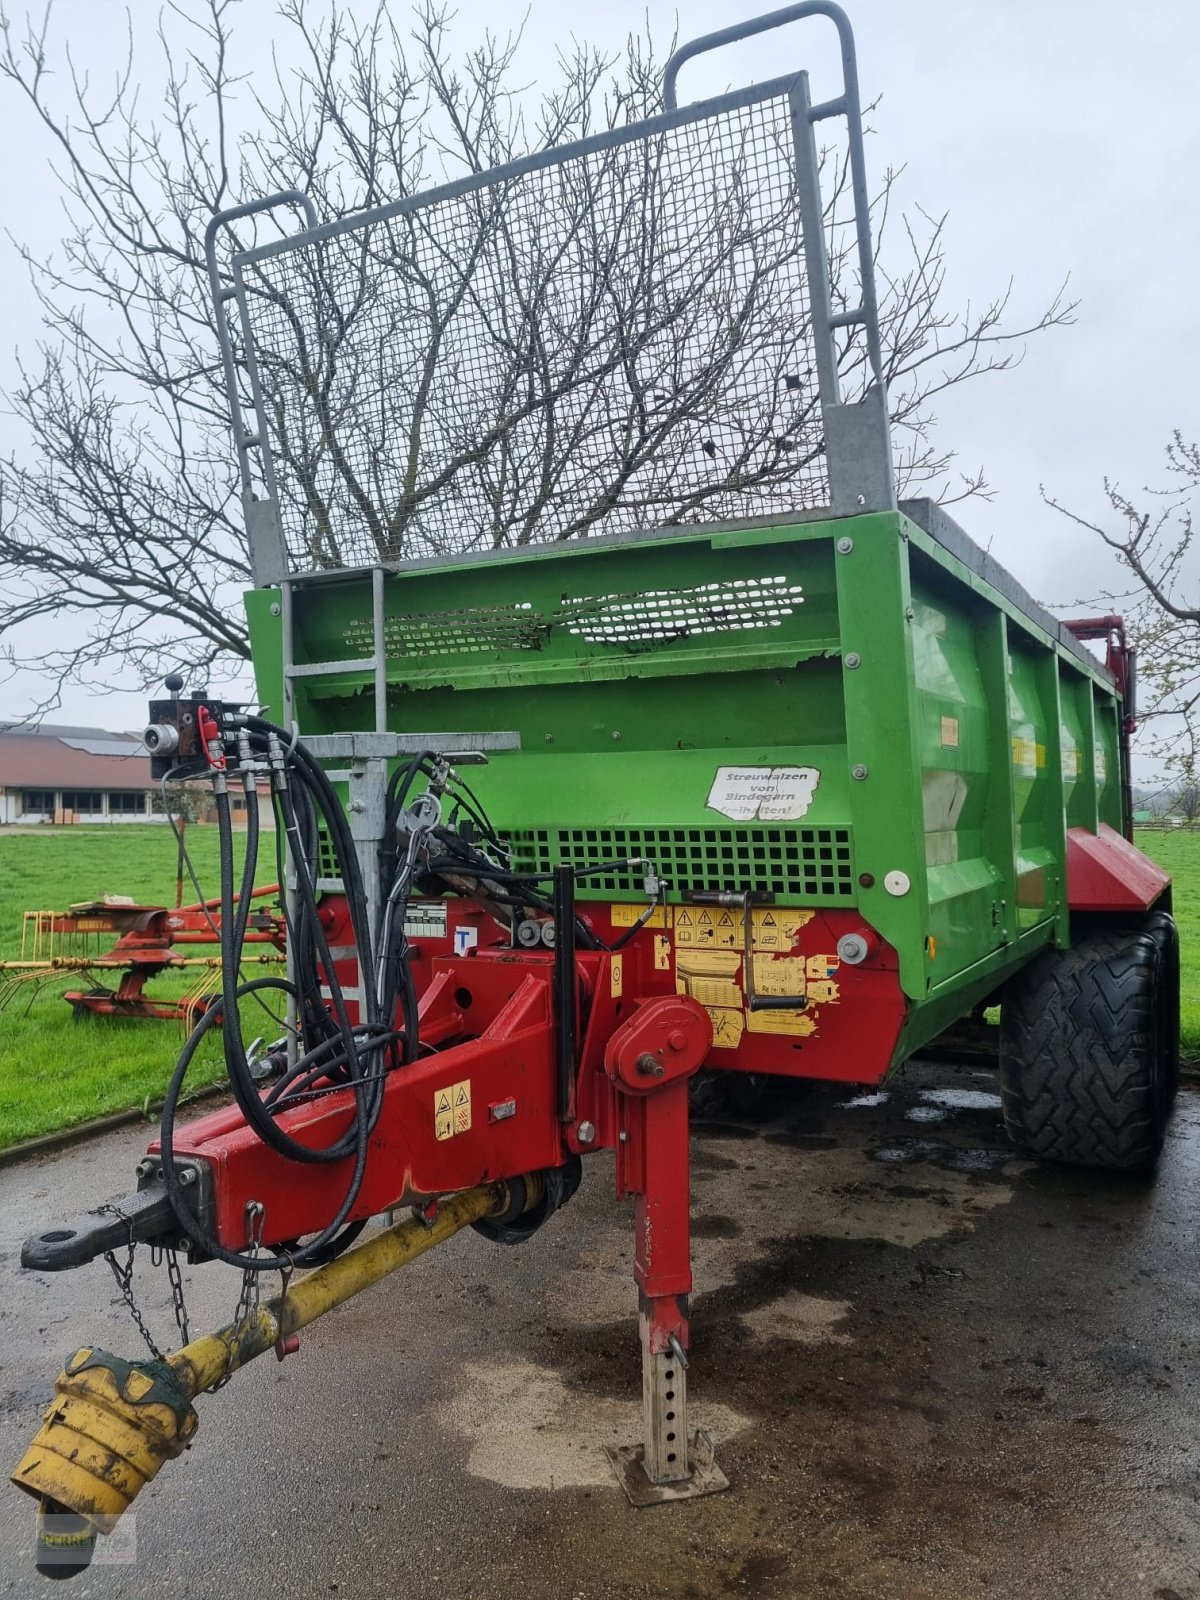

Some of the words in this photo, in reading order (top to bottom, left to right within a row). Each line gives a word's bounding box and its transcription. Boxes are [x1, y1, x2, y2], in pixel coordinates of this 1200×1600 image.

[725, 772, 808, 781] Streuwalzen
[724, 792, 796, 802] Bindegarn
[456, 930, 470, 951] T
